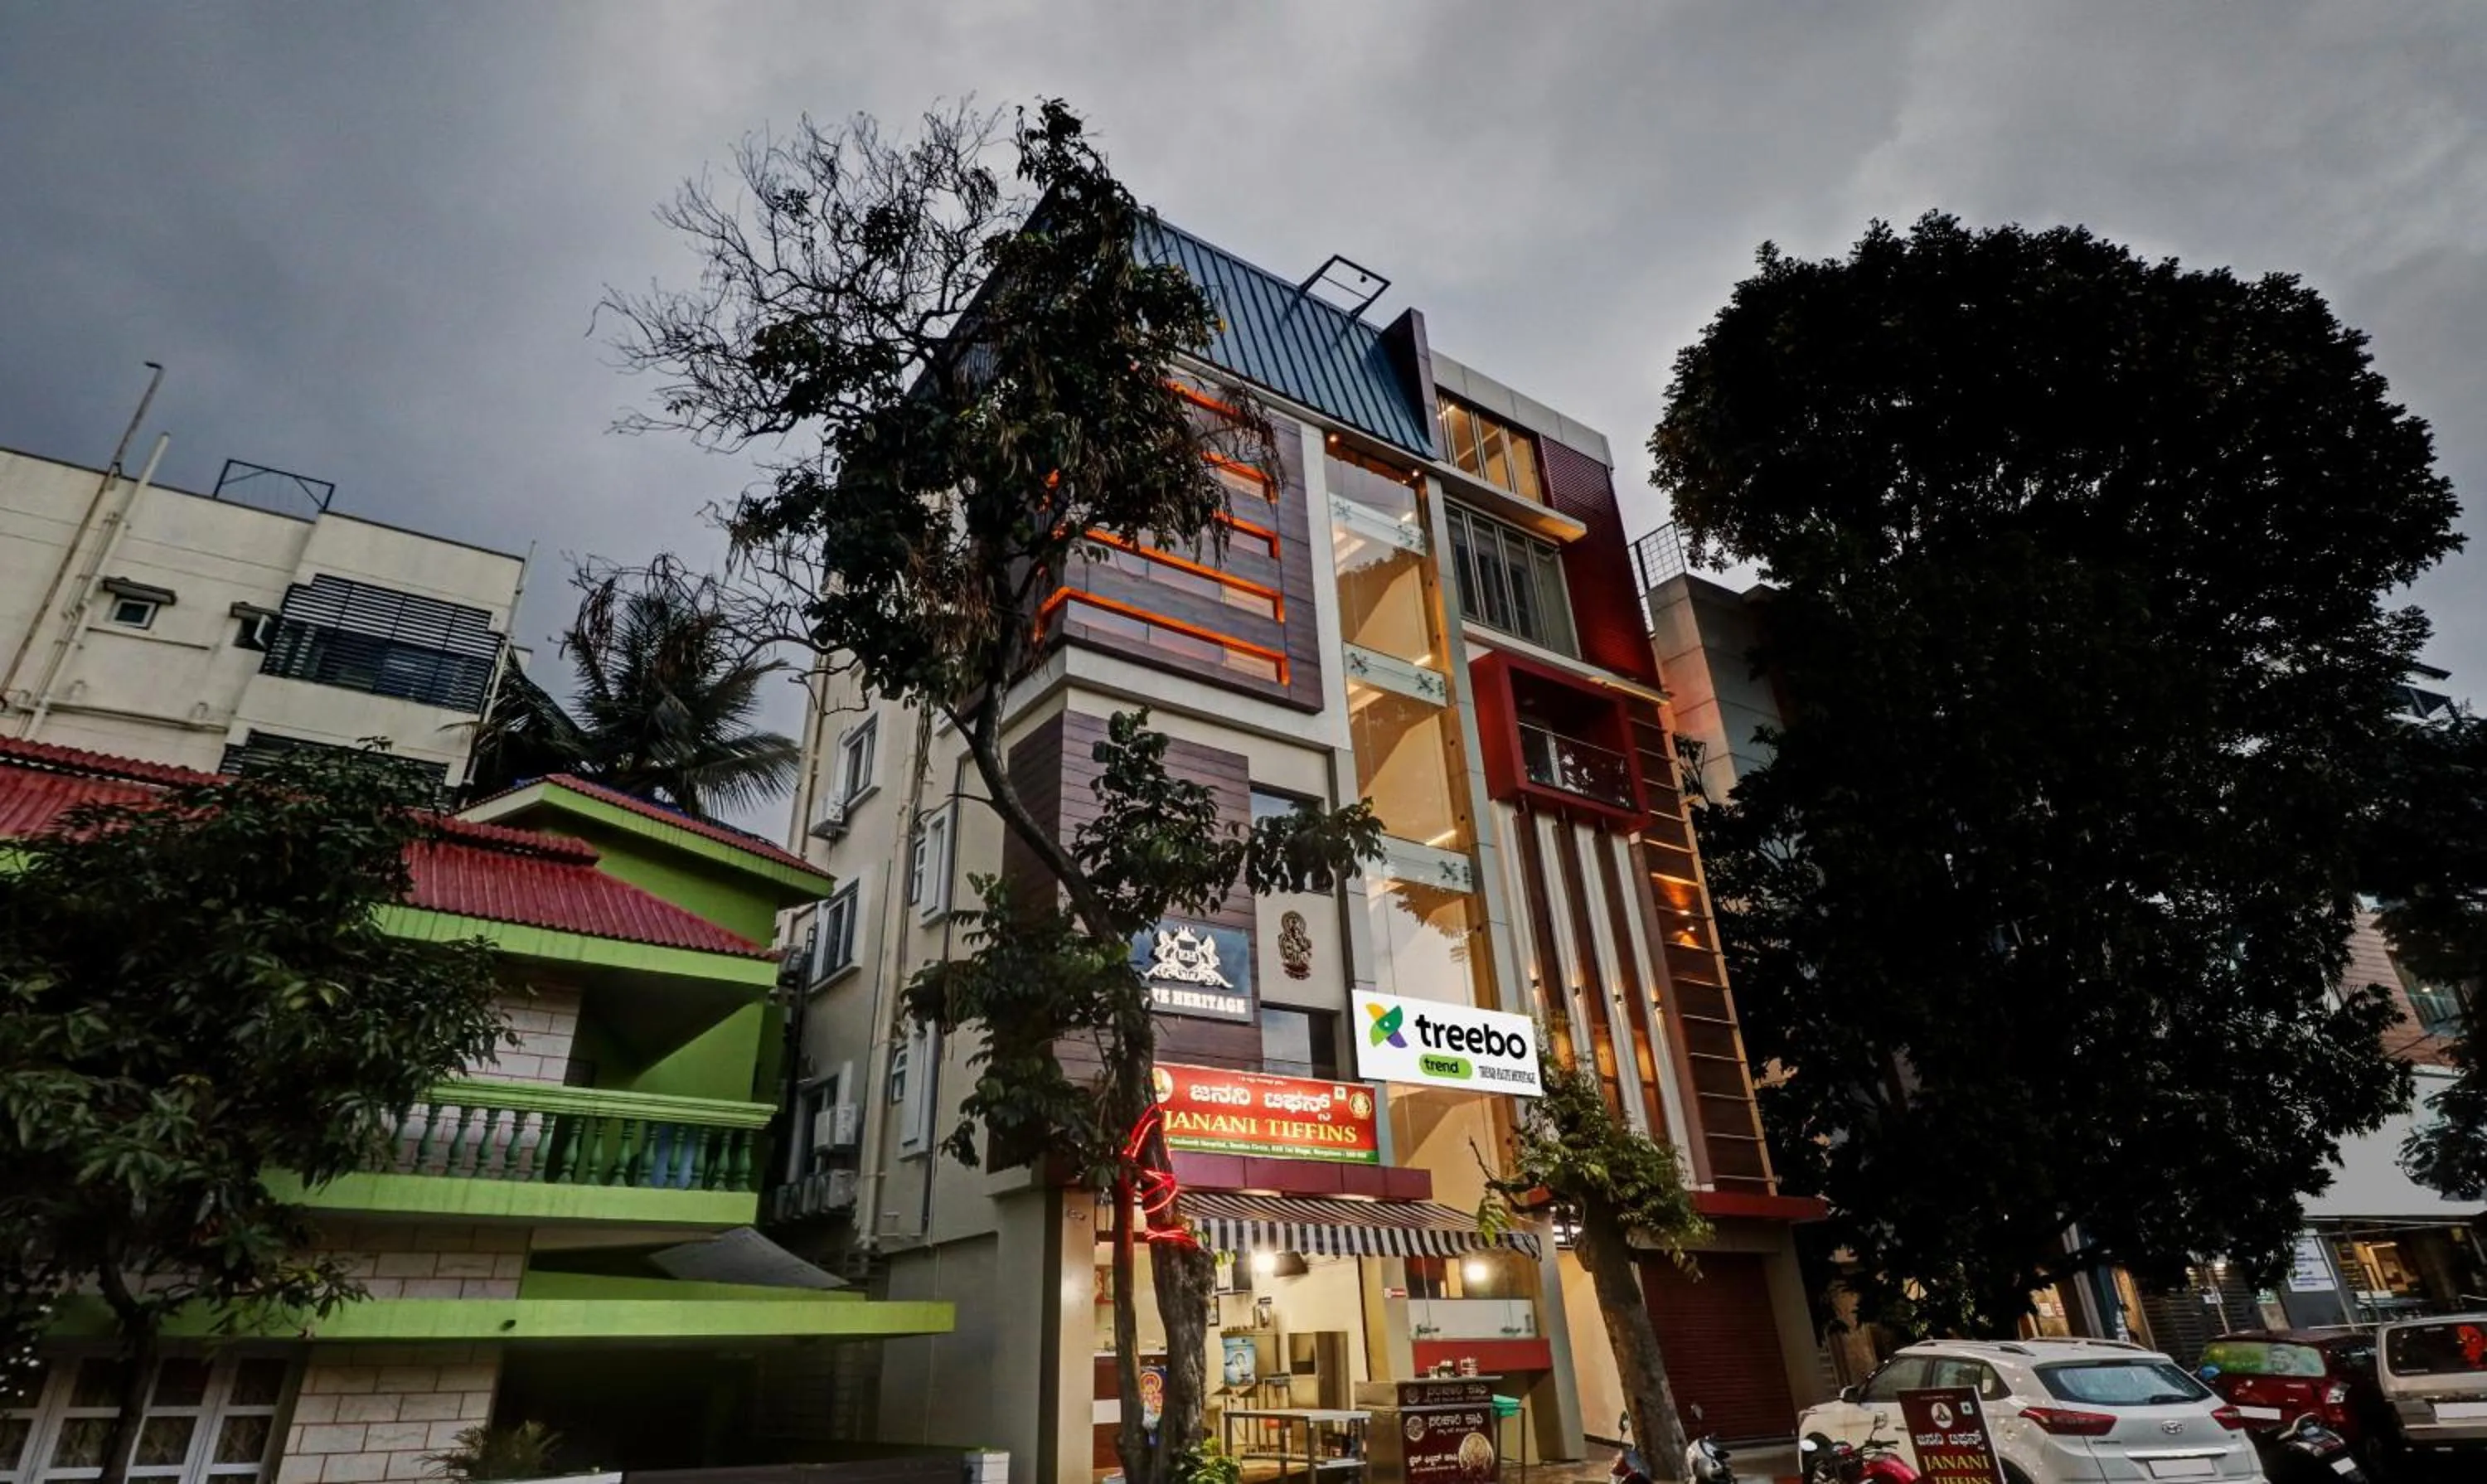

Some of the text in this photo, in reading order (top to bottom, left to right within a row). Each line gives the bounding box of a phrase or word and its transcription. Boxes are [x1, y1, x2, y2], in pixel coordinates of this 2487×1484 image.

[1171, 990, 1246, 1013] HERITAGE
[1414, 1014, 1527, 1060] treebo
[1423, 1057, 1460, 1074] trend
[1189, 1083, 1251, 1106] ಜನನಿ
[1164, 1110, 1357, 1143] JANANI TIFFINS
[1923, 1455, 1990, 1472] JANANI
